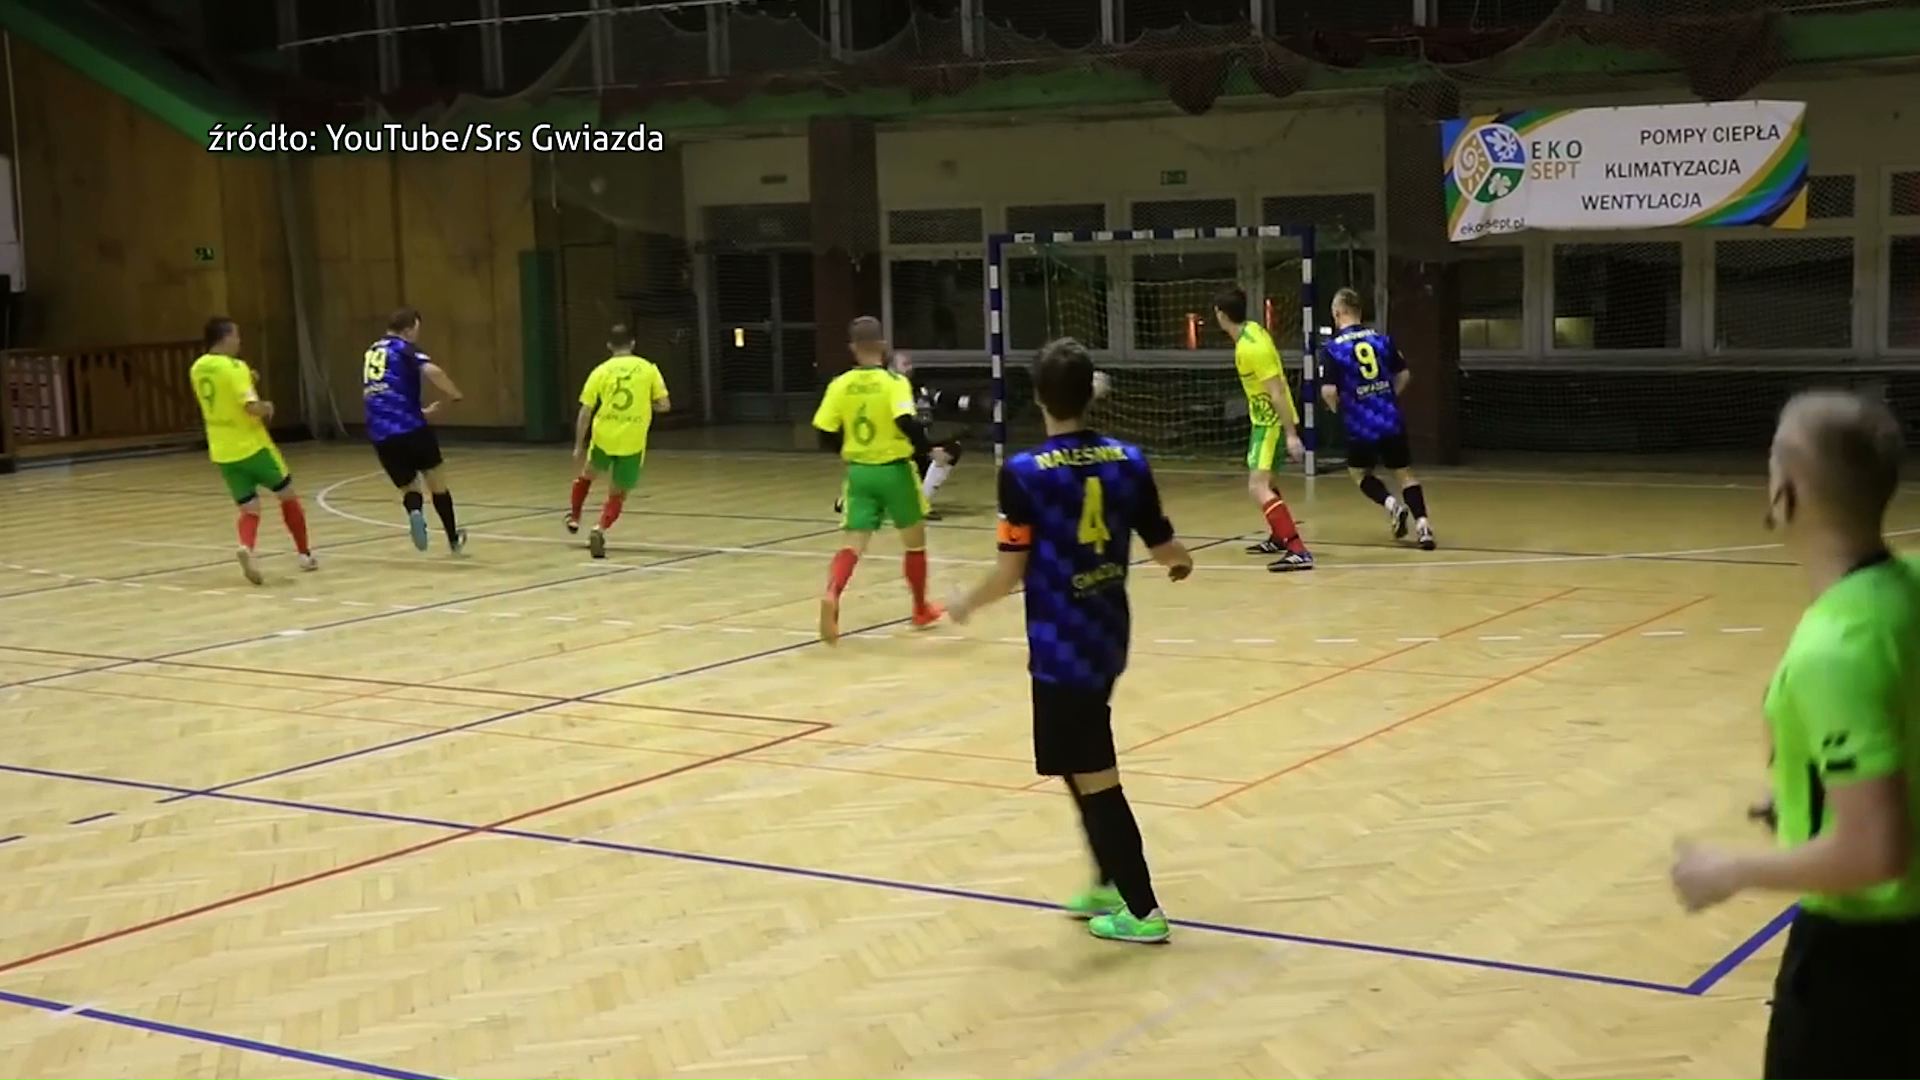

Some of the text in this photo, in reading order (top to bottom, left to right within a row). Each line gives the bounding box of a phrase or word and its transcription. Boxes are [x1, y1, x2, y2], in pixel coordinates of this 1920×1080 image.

[1639, 124, 1782, 146] POMPY CIEPŁA
[1531, 140, 1583, 160] EKO
[1531, 160, 1582, 180] SEPT
[1604, 160, 1742, 179] KLIMATYZACJA
[1581, 193, 1703, 212] WENTYLACJA
[363, 347, 387, 384] 19
[1354, 341, 1379, 380] 9
[612, 375, 634, 411] 5
[854, 402, 876, 446] 6
[1077, 476, 1112, 555] 4
